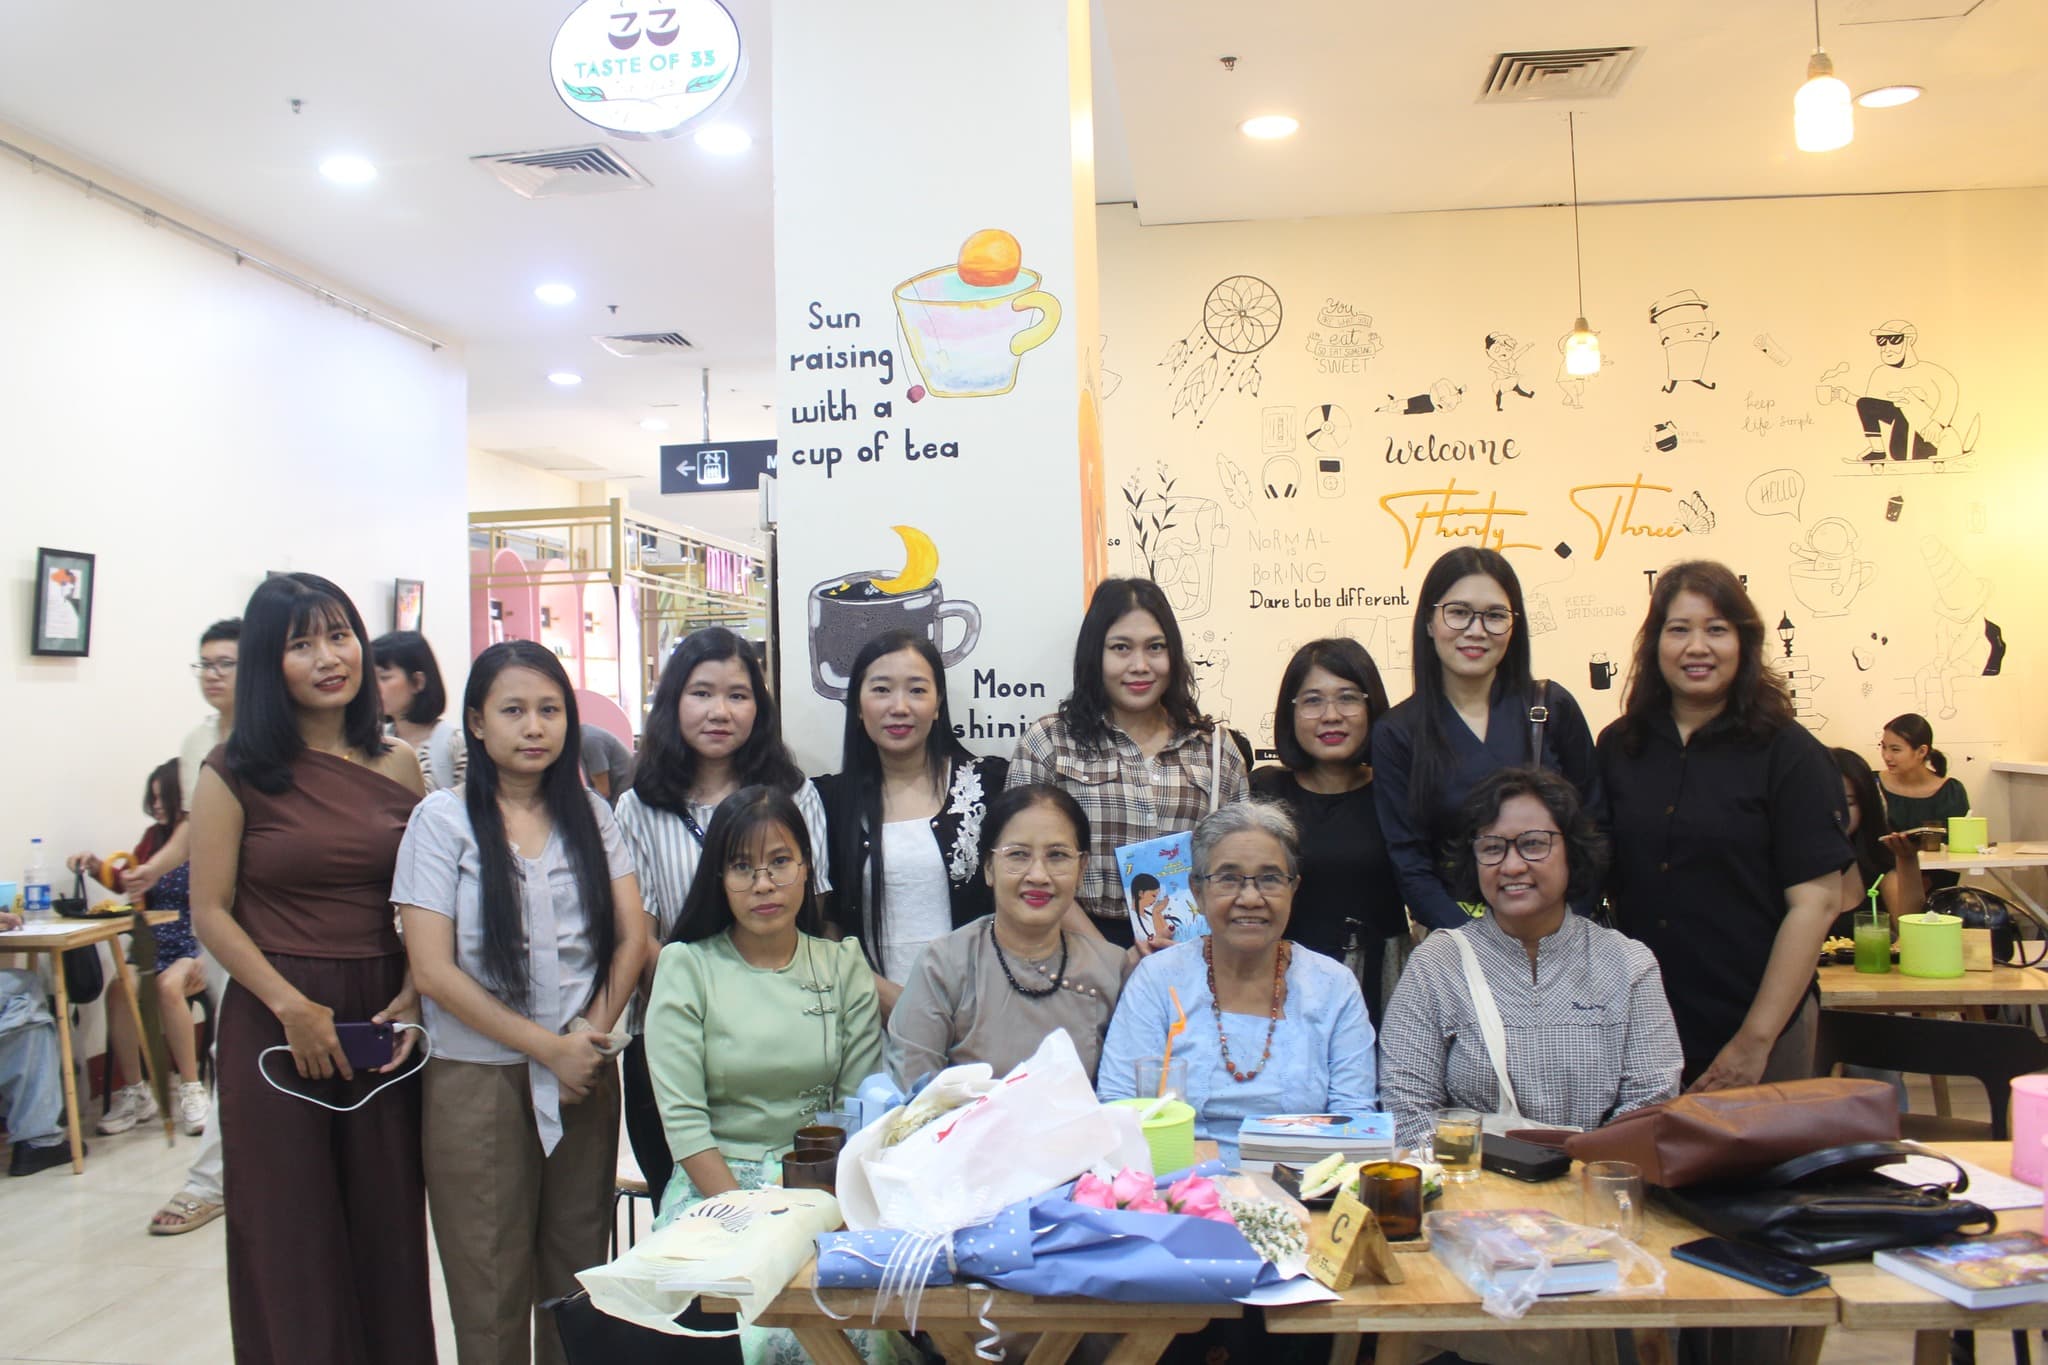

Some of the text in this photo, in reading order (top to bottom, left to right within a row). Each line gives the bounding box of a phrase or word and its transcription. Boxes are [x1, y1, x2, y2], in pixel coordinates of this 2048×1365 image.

[574, 57, 641, 79] TASTE
[649, 53, 680, 72] OF
[808, 301, 861, 330] Sun
[1329, 327, 1361, 346] eat
[790, 344, 894, 385] raising
[792, 388, 892, 424] with a
[792, 428, 959, 479] cup of tea
[1760, 476, 1797, 504] HELLO
[1569, 473, 1685, 560] Three
[1250, 586, 1409, 609] Dare to be different
[973, 668, 1046, 699] Moon
[952, 708, 1033, 739] shini
[1331, 1213, 1350, 1244] C
